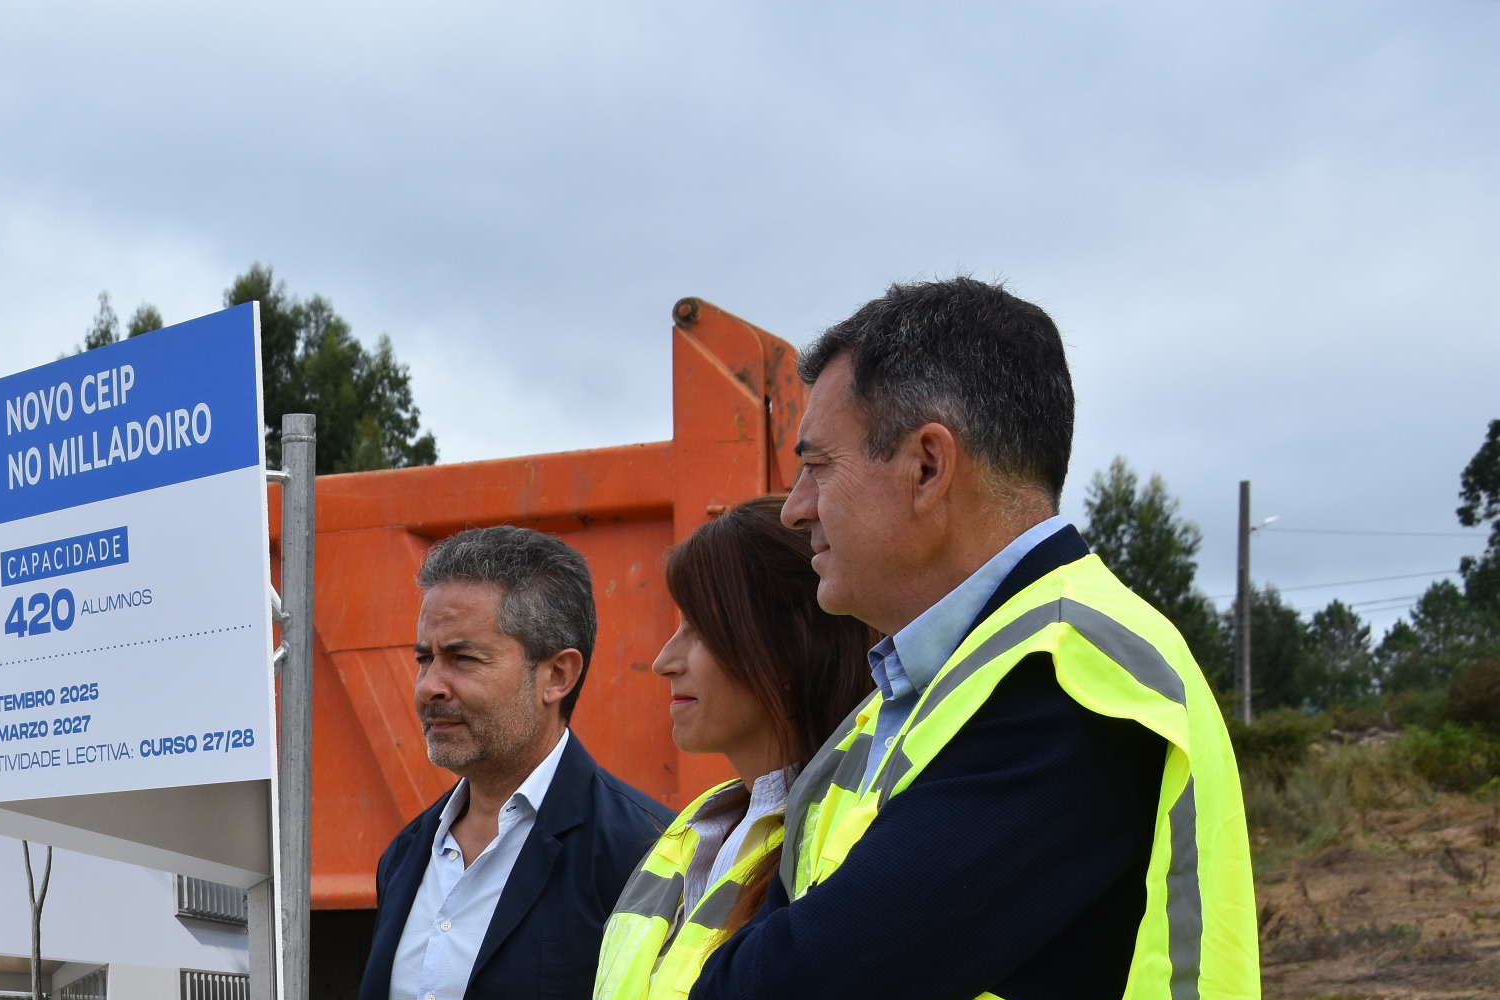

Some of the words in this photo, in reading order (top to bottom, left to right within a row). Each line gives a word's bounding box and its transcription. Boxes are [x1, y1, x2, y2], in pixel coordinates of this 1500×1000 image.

[6, 381, 74, 436] NOVO
[80, 364, 135, 415] CEIP
[8, 446, 42, 490] NO
[48, 402, 212, 480] MILLADOIRO
[7, 534, 122, 579] CAPACIDADE
[4, 588, 76, 638] 420
[80, 588, 153, 616] ALUMNOS
[59, 682, 99, 705] 2025
[53, 714, 92, 736] 2027
[66, 742, 134, 766] LECTIVA:
[139, 734, 198, 758] CURSO
[202, 728, 255, 753] 27/28
